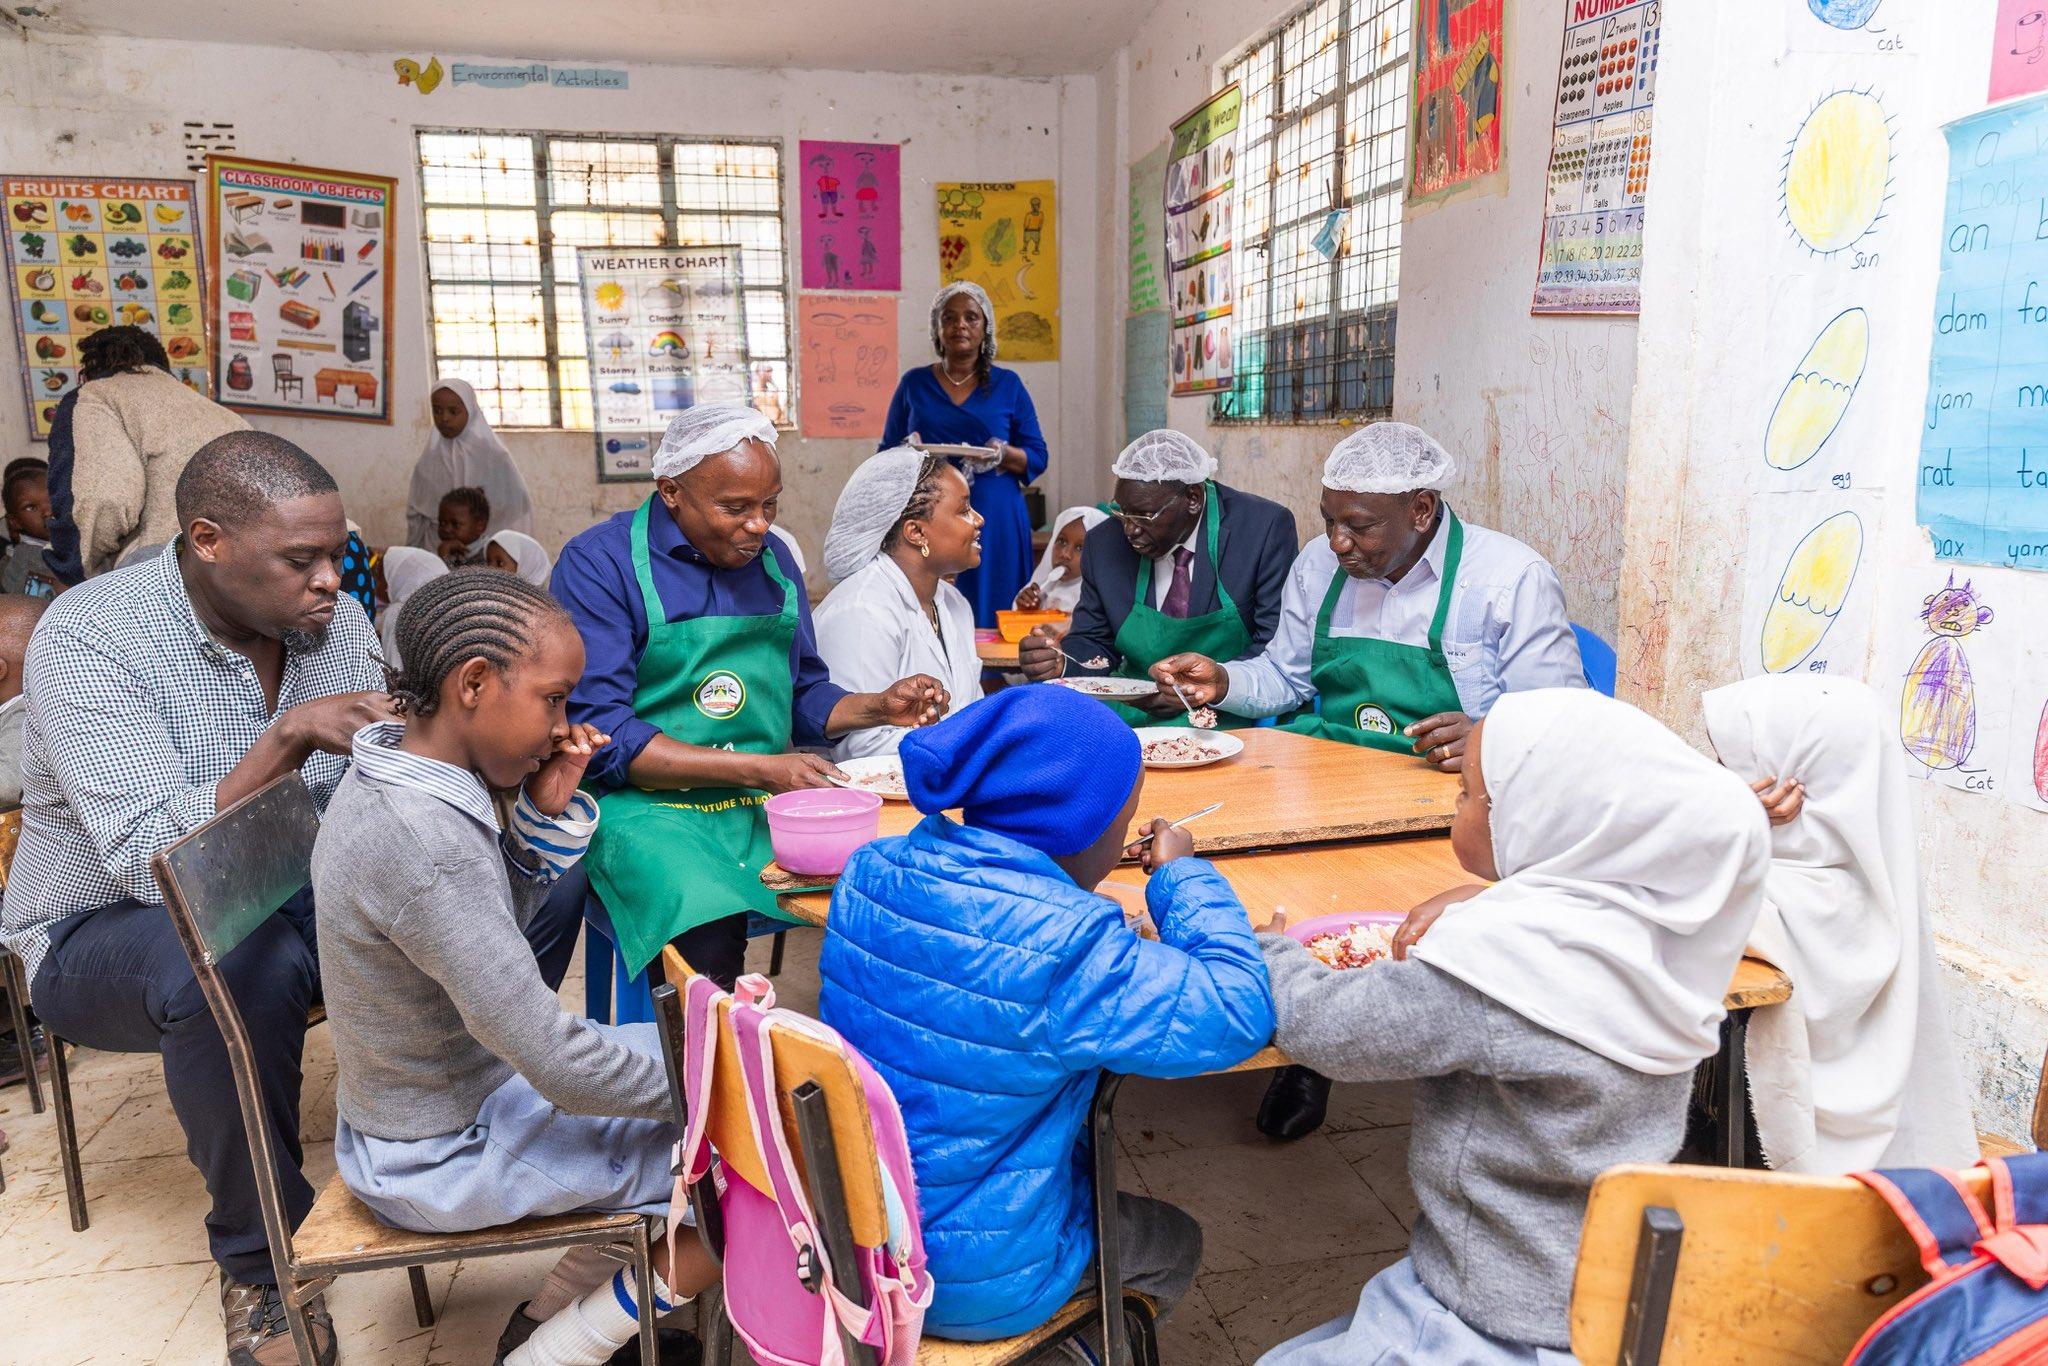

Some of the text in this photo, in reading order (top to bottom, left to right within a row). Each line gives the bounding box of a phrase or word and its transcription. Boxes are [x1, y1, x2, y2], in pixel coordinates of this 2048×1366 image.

[1643, 1, 1659, 28] 13
[1602, 16, 1637, 40] 12 Twelve
[1566, 30, 1596, 51] 11 Eleven
[1878, 34, 1903, 50] cat
[452, 64, 619, 87] Environmental Activities
[1559, 108, 1591, 121] Sharpeners
[1602, 100, 1623, 113] Apples
[1214, 104, 1237, 129] wear
[1633, 110, 1646, 132] 18
[1601, 126, 1631, 138] Seventeen
[9, 182, 184, 200] FRUITS CHART
[225, 171, 382, 202] CLASSROOM OBJECTS
[1959, 161, 2024, 214] Look
[1555, 204, 1572, 213] Books
[1593, 199, 1609, 209] Balls
[1558, 221, 1565, 237] 2
[1569, 220, 1577, 236] 3
[1582, 218, 1590, 235] 4
[1595, 217, 1604, 234] 5
[1609, 214, 1617, 233] 6
[1624, 214, 1632, 231] 7
[1636, 212, 1644, 230] 8
[1949, 224, 1989, 252] an
[1590, 246, 1602, 260] 20
[1605, 246, 1615, 259] 21
[1617, 244, 1629, 258] 22
[1630, 244, 1643, 257] 23
[592, 256, 728, 271] WEATHER CHART
[1541, 267, 1640, 283] 31 32 33 34 35 36 37 38
[598, 316, 630, 325] Sunny
[649, 314, 684, 324] Cloudy
[1939, 293, 1986, 334] dam
[600, 367, 636, 375] Stormy
[649, 365, 691, 374] Rainbow
[1928, 385, 1972, 430] jam
[608, 416, 641, 425] Snowy
[616, 460, 639, 468] Cold
[1923, 448, 1954, 486] rat
[1831, 472, 1851, 489] egg
[1965, 776, 1994, 789] Cat
[740, 796, 753, 806] YA
